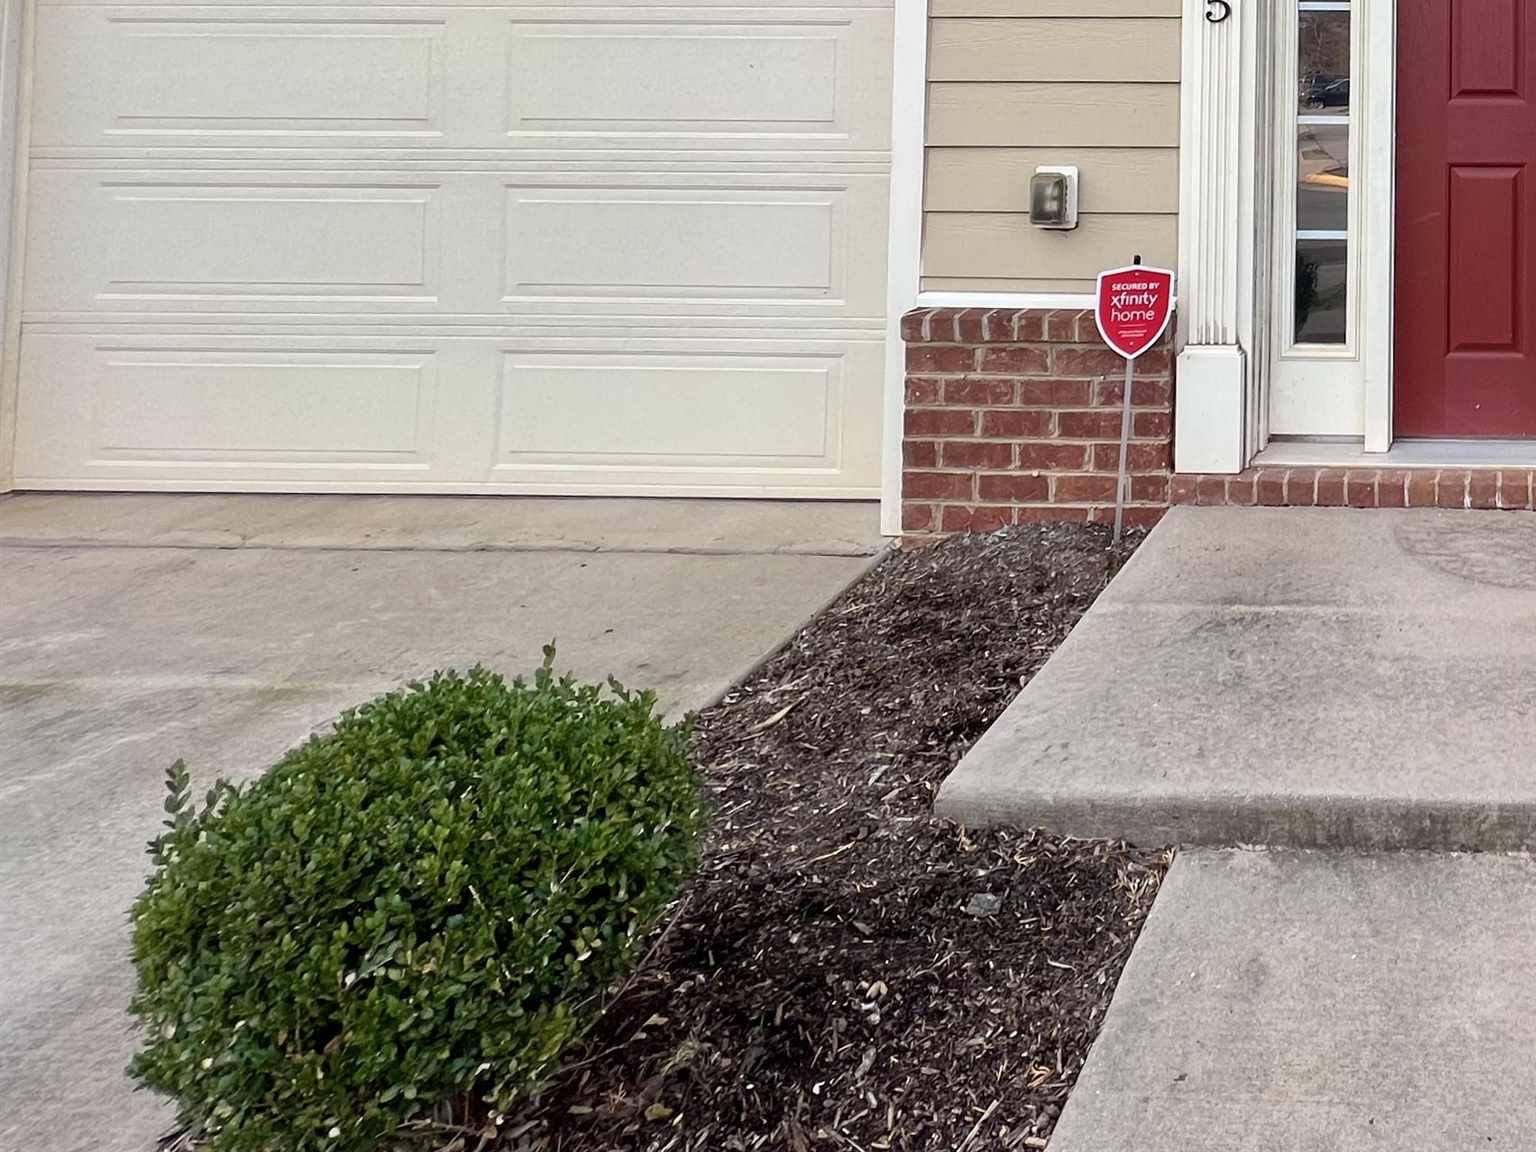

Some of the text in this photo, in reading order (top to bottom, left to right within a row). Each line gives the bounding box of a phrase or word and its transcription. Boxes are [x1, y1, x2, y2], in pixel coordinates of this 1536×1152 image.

[1112, 282, 1160, 291] SECURED BY
[1110, 291, 1158, 308] xfinity
[1111, 308, 1155, 322] home
